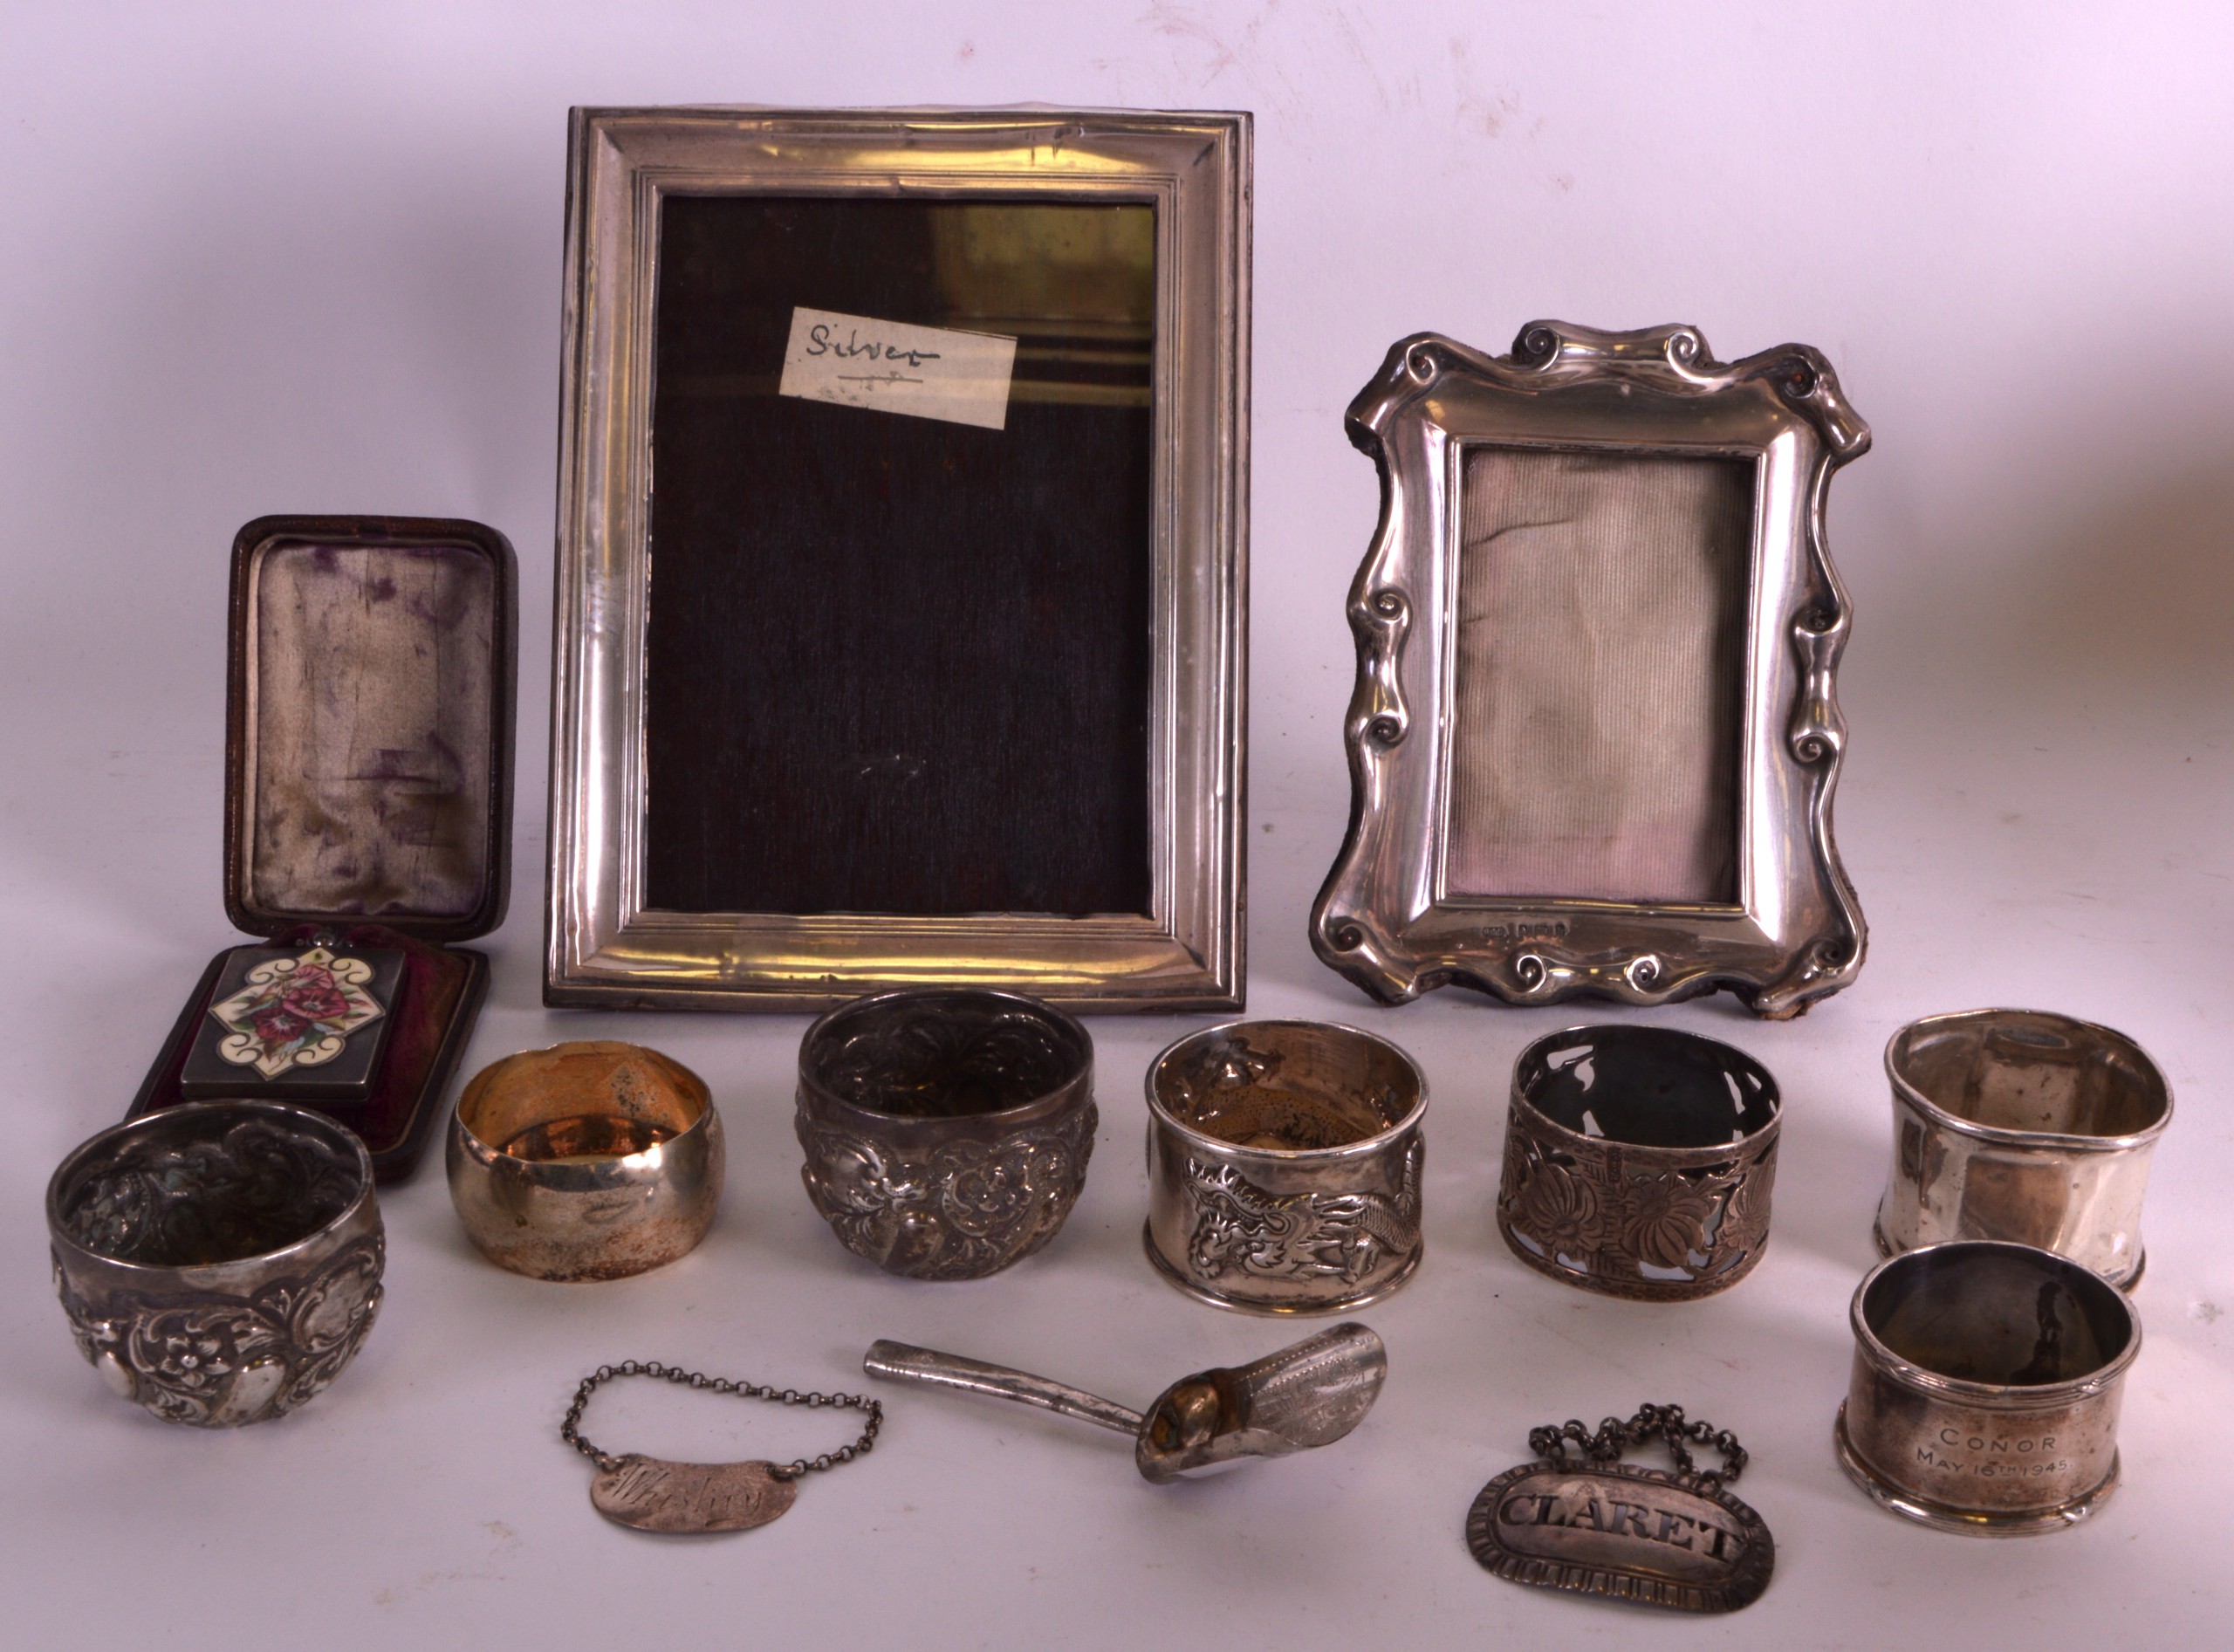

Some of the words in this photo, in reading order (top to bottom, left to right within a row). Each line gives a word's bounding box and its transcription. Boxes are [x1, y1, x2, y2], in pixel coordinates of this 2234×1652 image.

[806, 324, 941, 367] Silver
[1940, 1429, 2056, 1453] CONOR
[1499, 1494, 1744, 1565] CLARET
